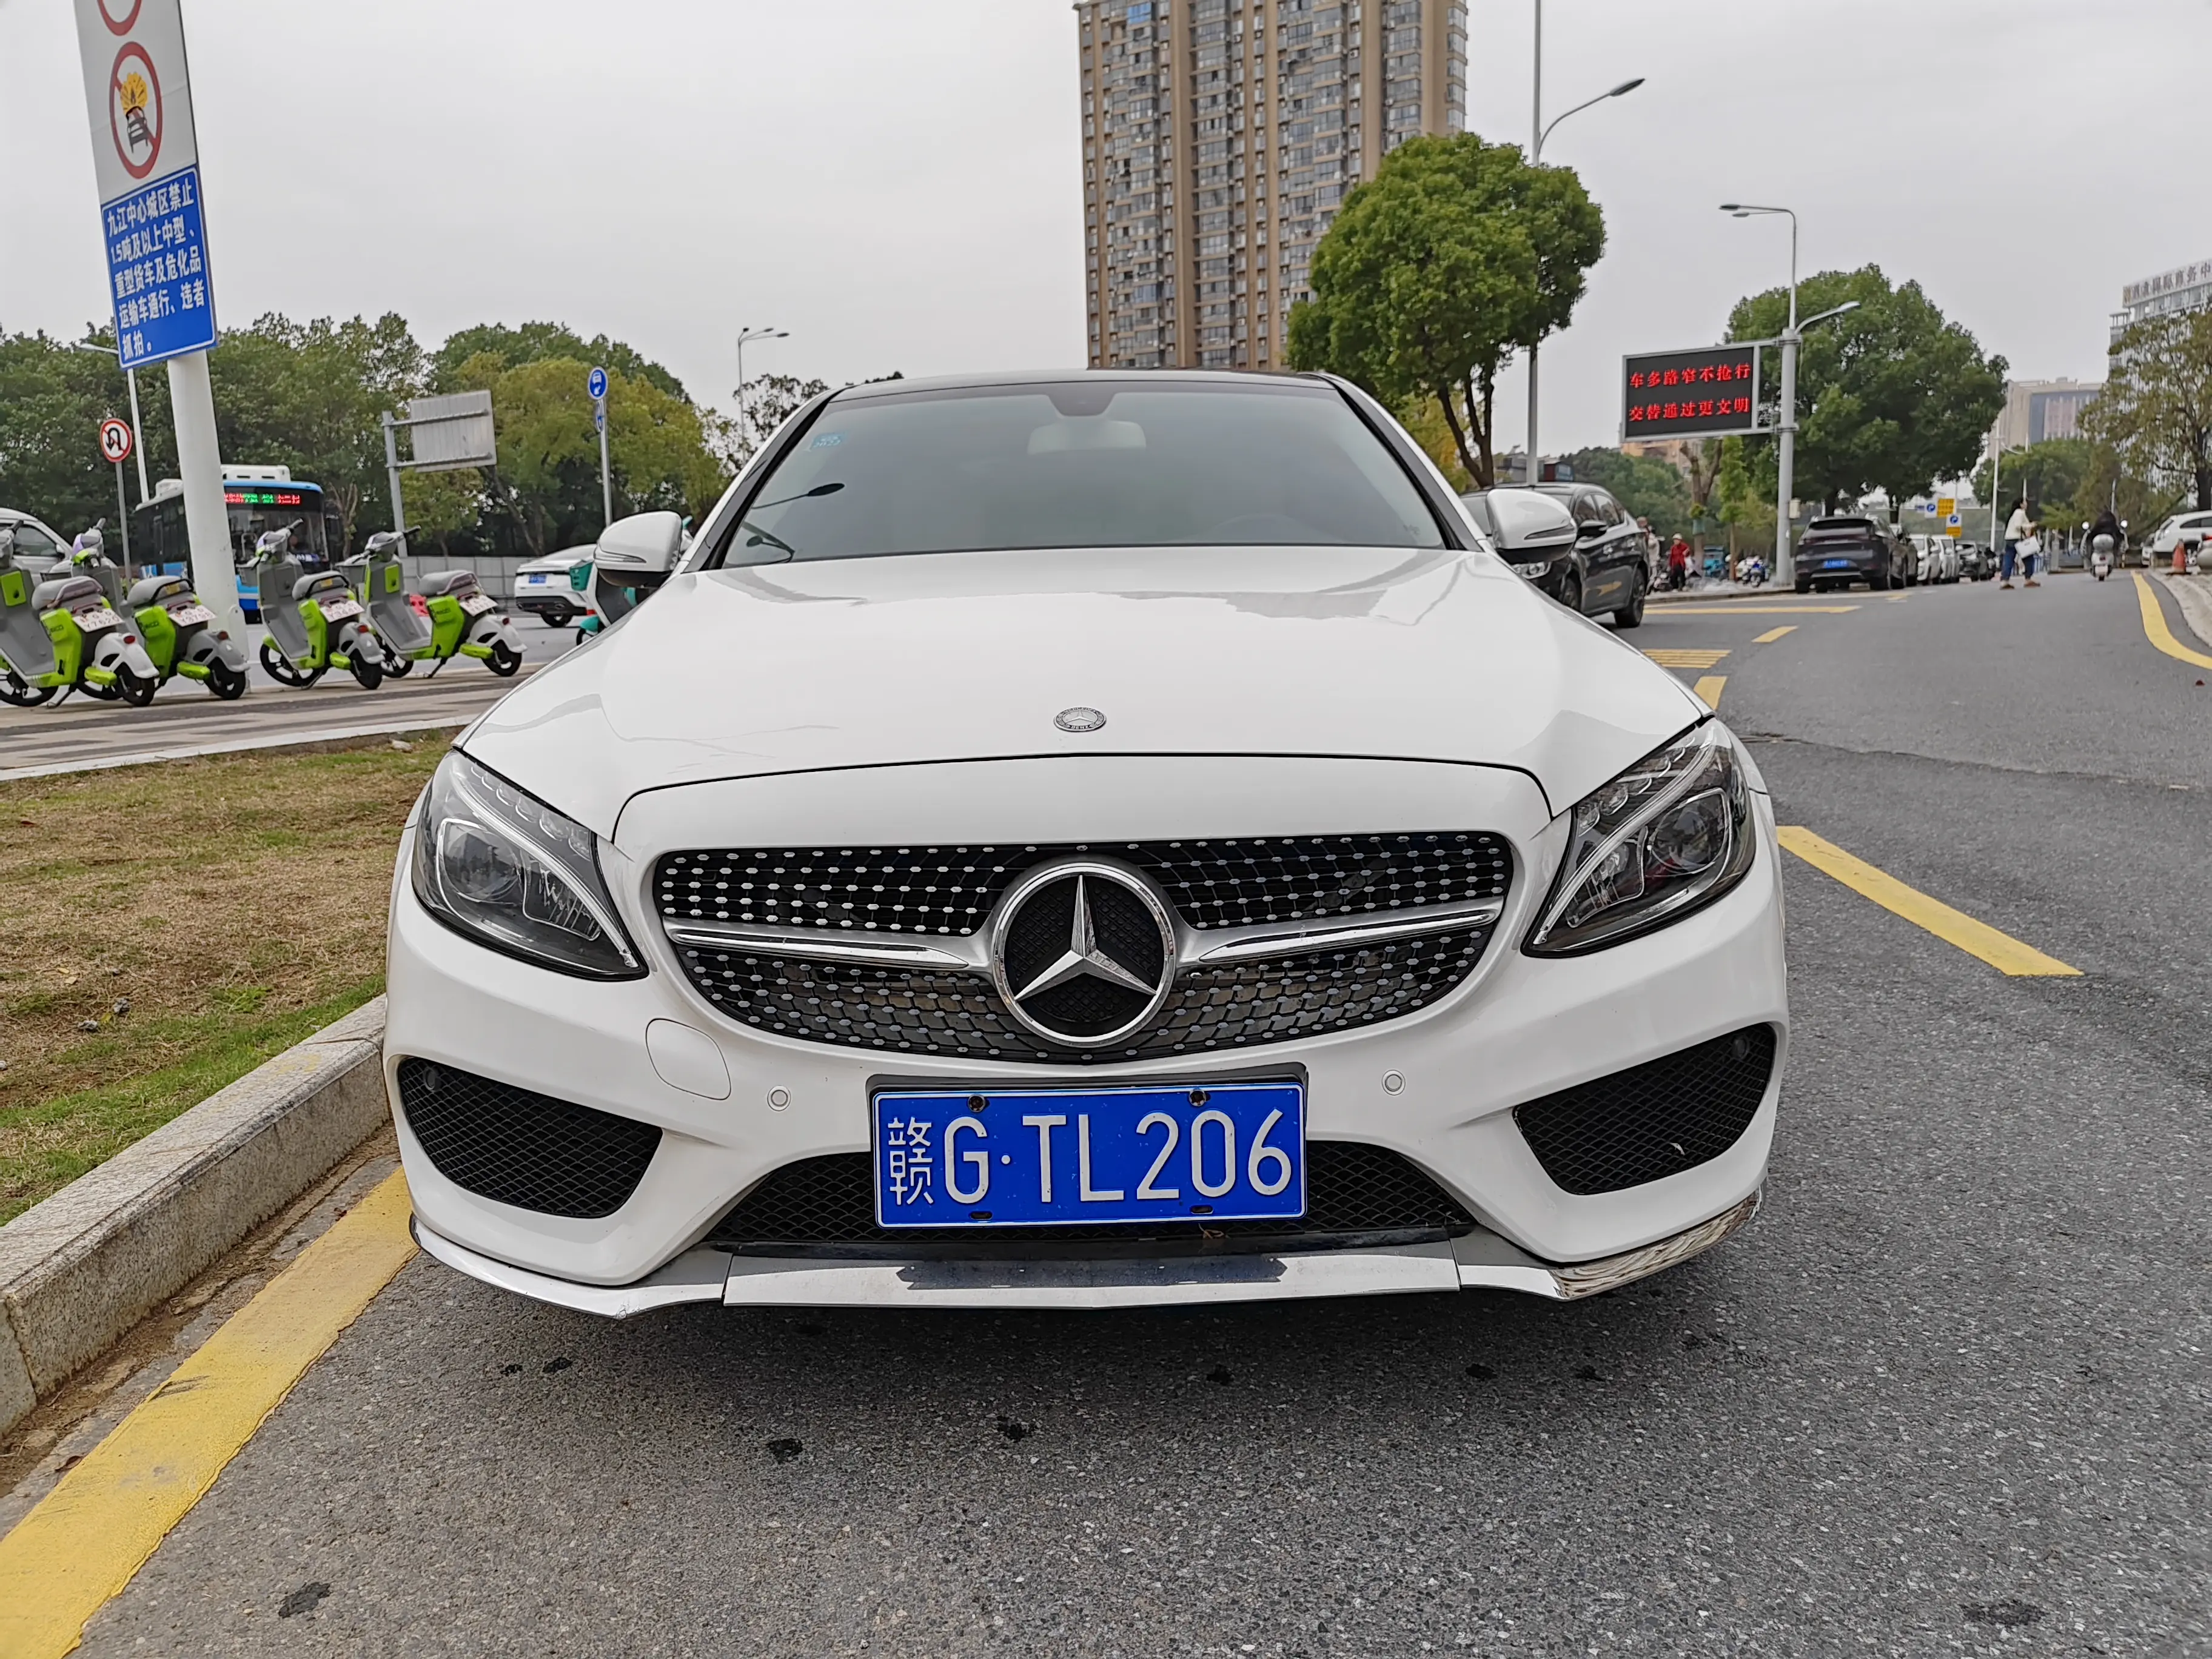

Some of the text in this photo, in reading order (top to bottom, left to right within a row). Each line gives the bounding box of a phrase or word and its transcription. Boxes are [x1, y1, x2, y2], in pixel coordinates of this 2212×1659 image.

[107, 177, 195, 238] 九江中心城区禁止
[114, 245, 202, 300] 重型货车及危化品
[1629, 362, 1751, 389] 车多路窄不抢行
[1629, 397, 1750, 421] 交替通过更文明
